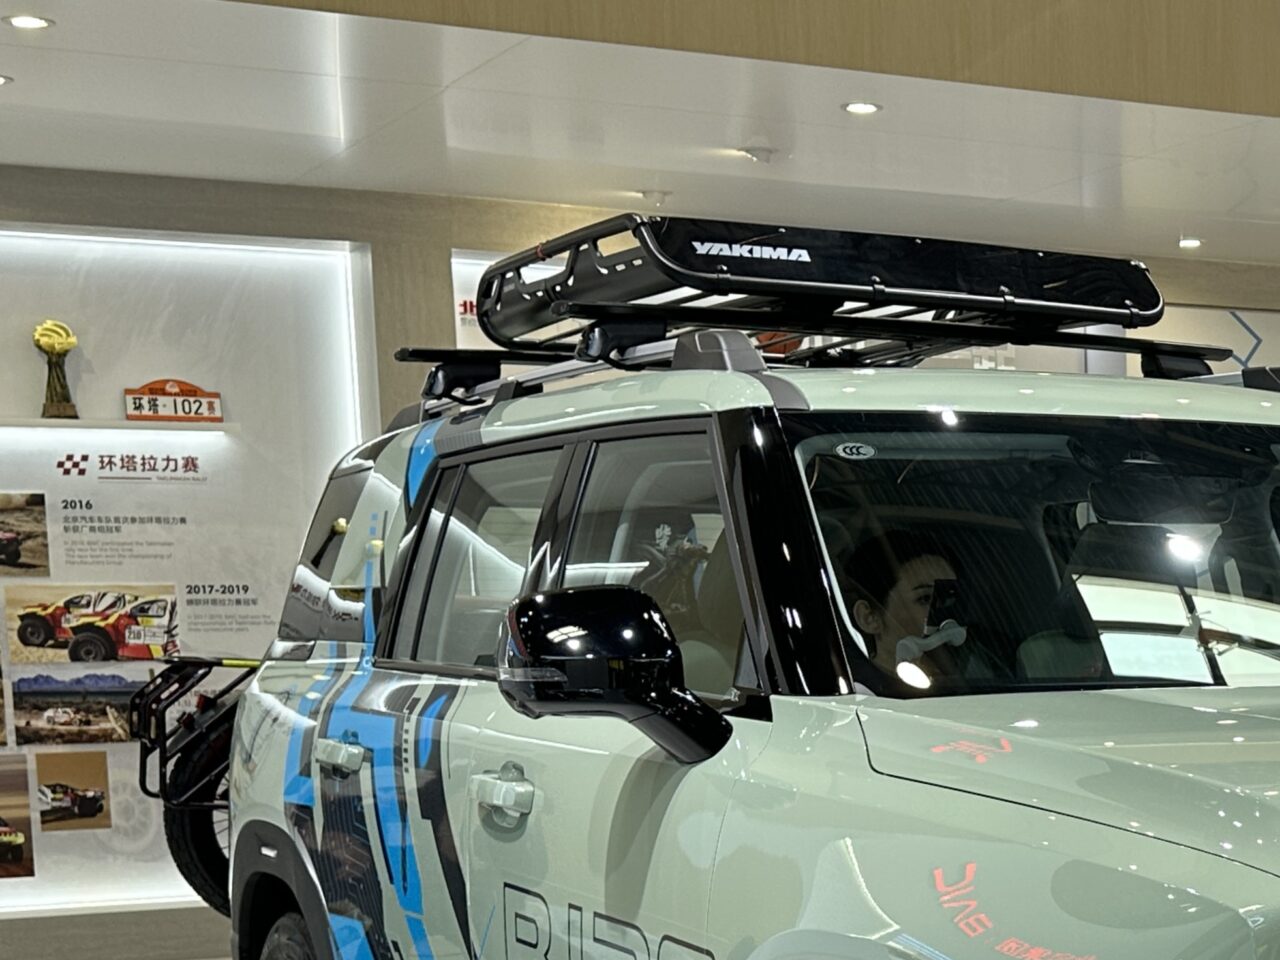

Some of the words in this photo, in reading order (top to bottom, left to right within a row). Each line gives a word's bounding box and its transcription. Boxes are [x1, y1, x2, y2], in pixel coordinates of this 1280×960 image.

[691, 241, 811, 262] YAKIMA
[98, 454, 200, 474] 环塔拉力赛
[61, 499, 94, 511] 2016
[185, 584, 250, 595] 2017-2019
